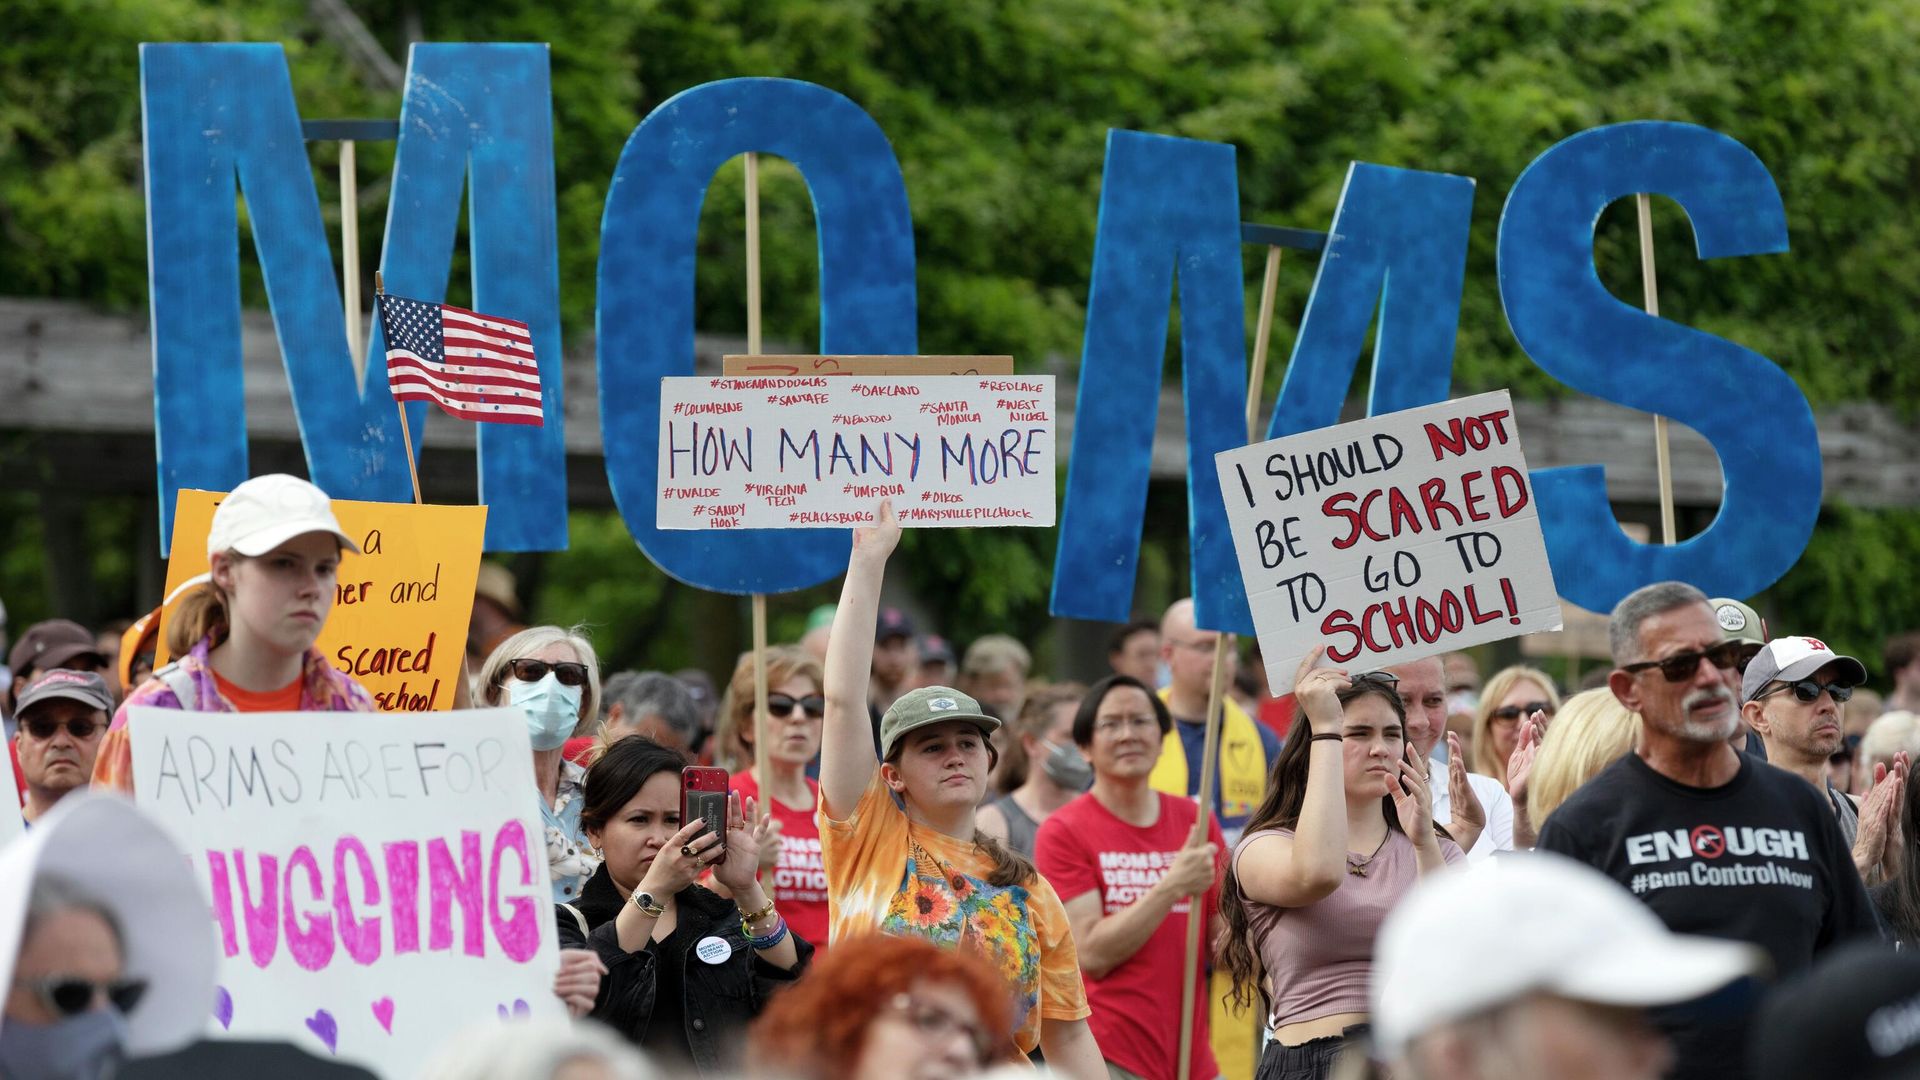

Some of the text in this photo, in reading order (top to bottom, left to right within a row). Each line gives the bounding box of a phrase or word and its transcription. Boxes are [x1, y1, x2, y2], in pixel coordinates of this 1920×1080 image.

[140, 43, 1824, 633] MOMS
[850, 384, 921, 396] #OAKLAND
[978, 380, 1043, 392] #REDLAKE
[767, 393, 830, 406] #SANTAFE
[919, 400, 969, 415] #SANTA
[995, 398, 1039, 410] #WEST
[673, 402, 743, 416] #COLUMBINE
[669, 421, 1045, 485] HOW MANY MORE
[1236, 408, 1511, 508] I SHOULD NOT
[663, 488, 721, 499] #UVALDE
[844, 483, 905, 497] #UMPQUA
[764, 496, 797, 507] TECH
[789, 511, 874, 523] #BLACKSBURG
[1255, 465, 1530, 568] BE SCARED
[363, 530, 382, 555] a
[390, 563, 441, 604] and
[1277, 532, 1501, 623] TO GO TO
[1320, 577, 1522, 664] SCHOOL!
[335, 631, 436, 676] scared
[156, 735, 302, 815] ARMS
[1626, 825, 1810, 865] ENOUGH
[1099, 851, 1162, 868] MOMS
[1104, 869, 1168, 886] DEMA
